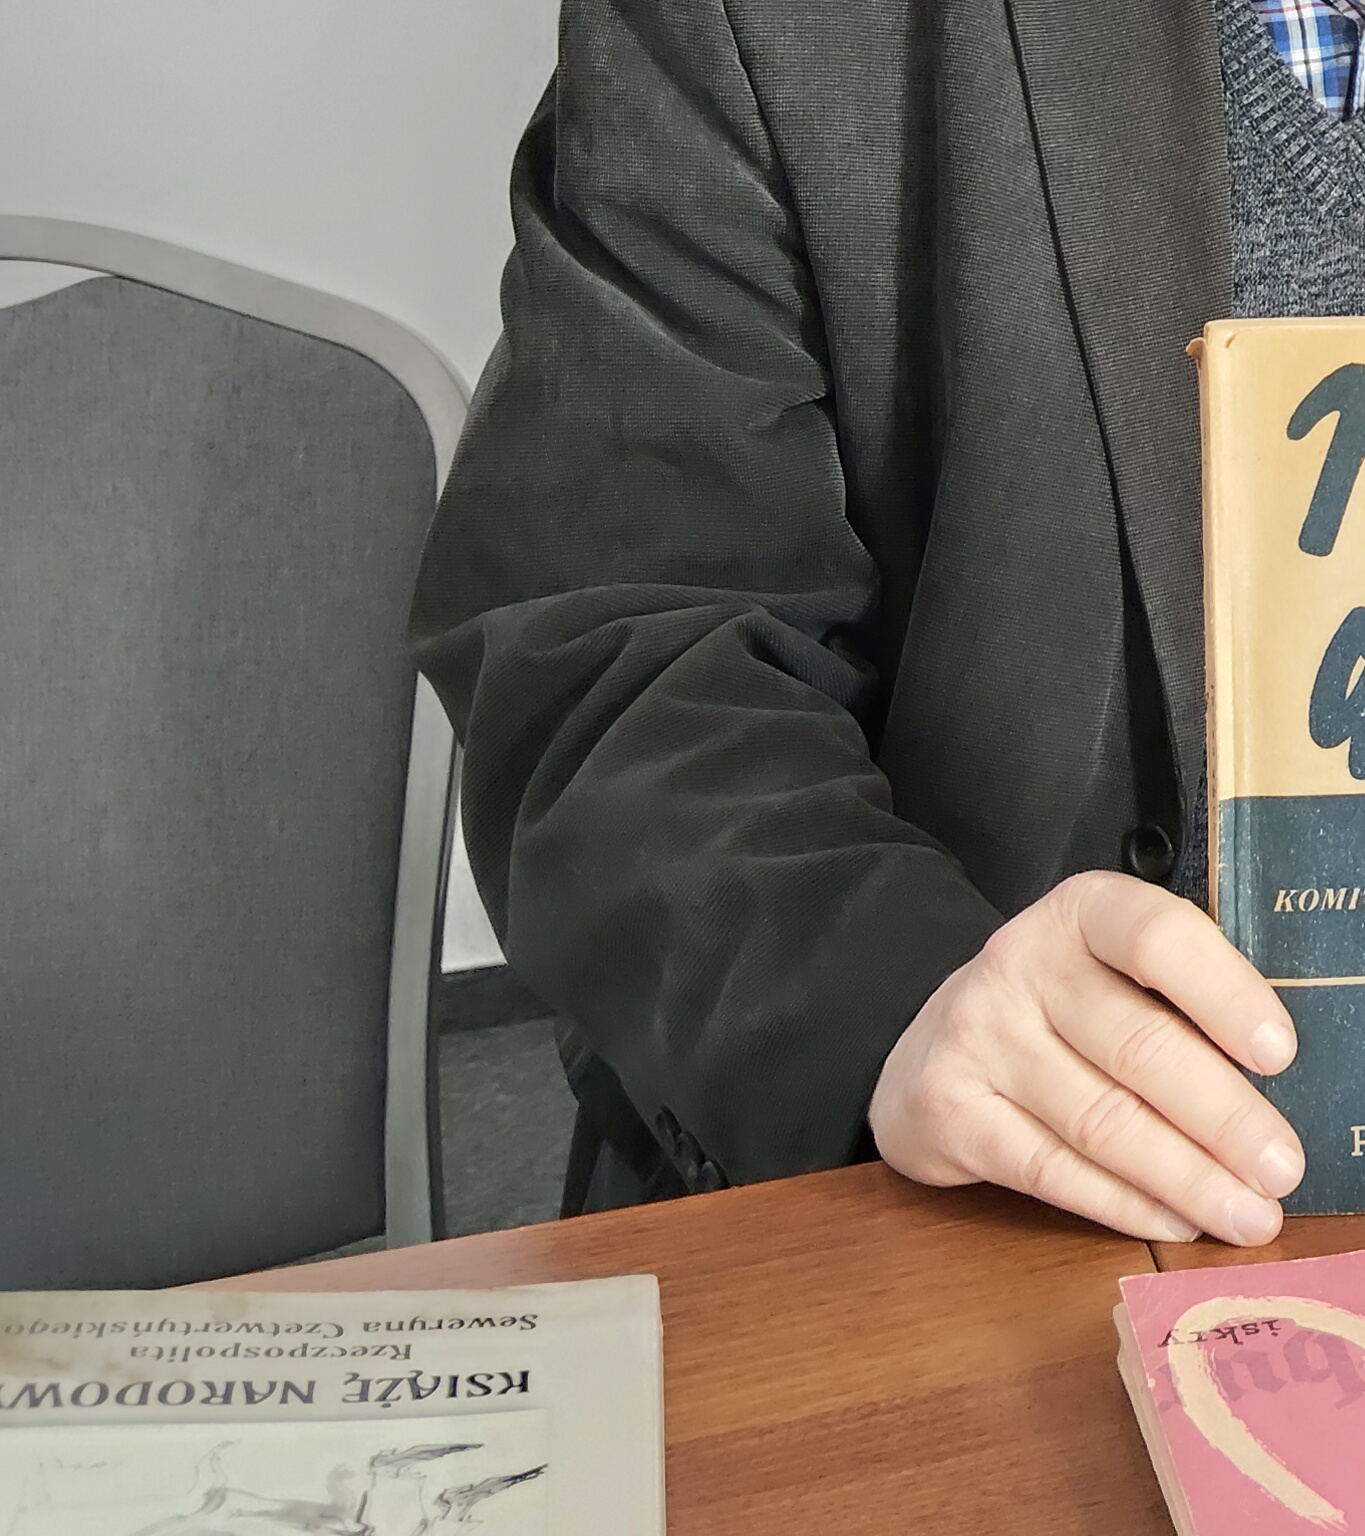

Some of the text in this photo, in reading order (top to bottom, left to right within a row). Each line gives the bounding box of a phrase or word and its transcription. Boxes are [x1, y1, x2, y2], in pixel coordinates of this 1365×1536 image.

[4, 1313, 540, 1340] Seweryna Czetwertyńskiego
[1157, 1319, 1281, 1348] iskry
[129, 1340, 412, 1363] Rzeczpospolita
[342, 1371, 531, 1409] KSIĄŻĘ
